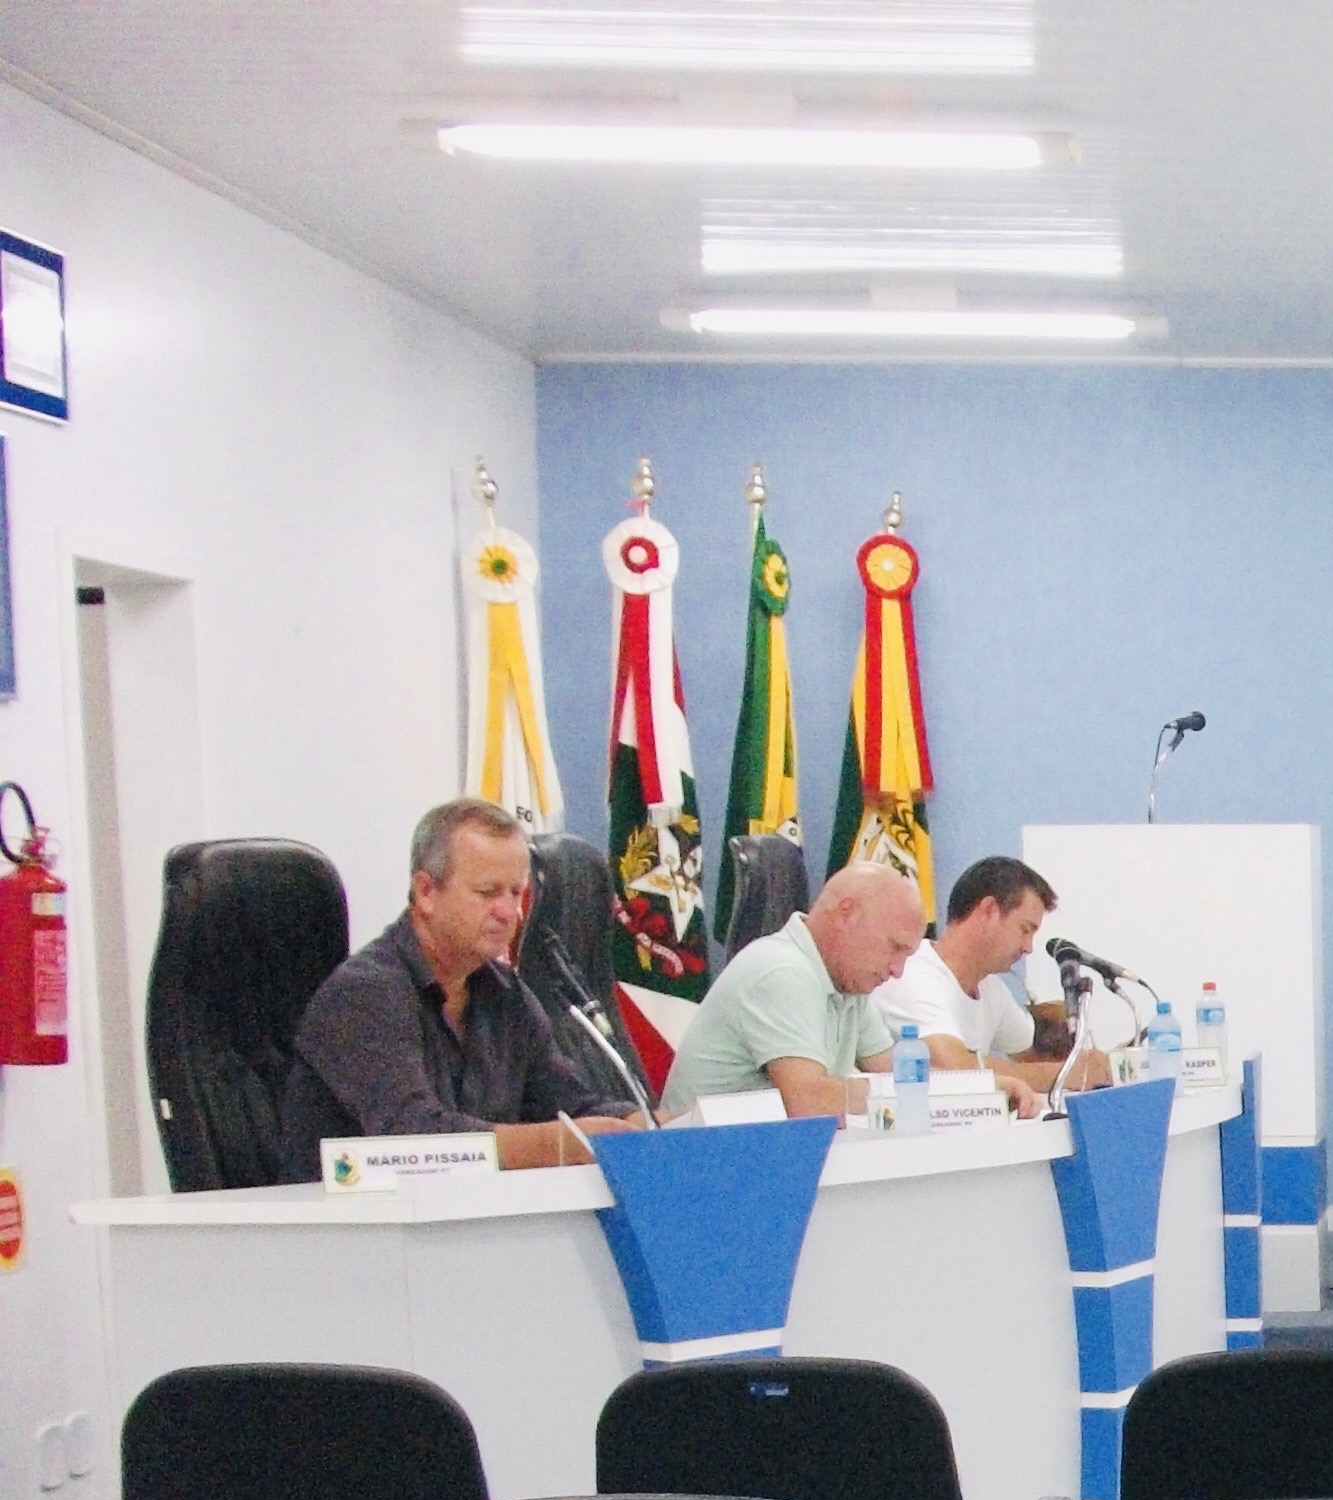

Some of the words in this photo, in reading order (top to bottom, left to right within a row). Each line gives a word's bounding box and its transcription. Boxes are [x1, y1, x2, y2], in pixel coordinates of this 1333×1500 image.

[952, 1106, 1002, 1118] VICENTIN
[366, 1155, 420, 1167] MARIO
[424, 1151, 487, 1164] PISSAIA
